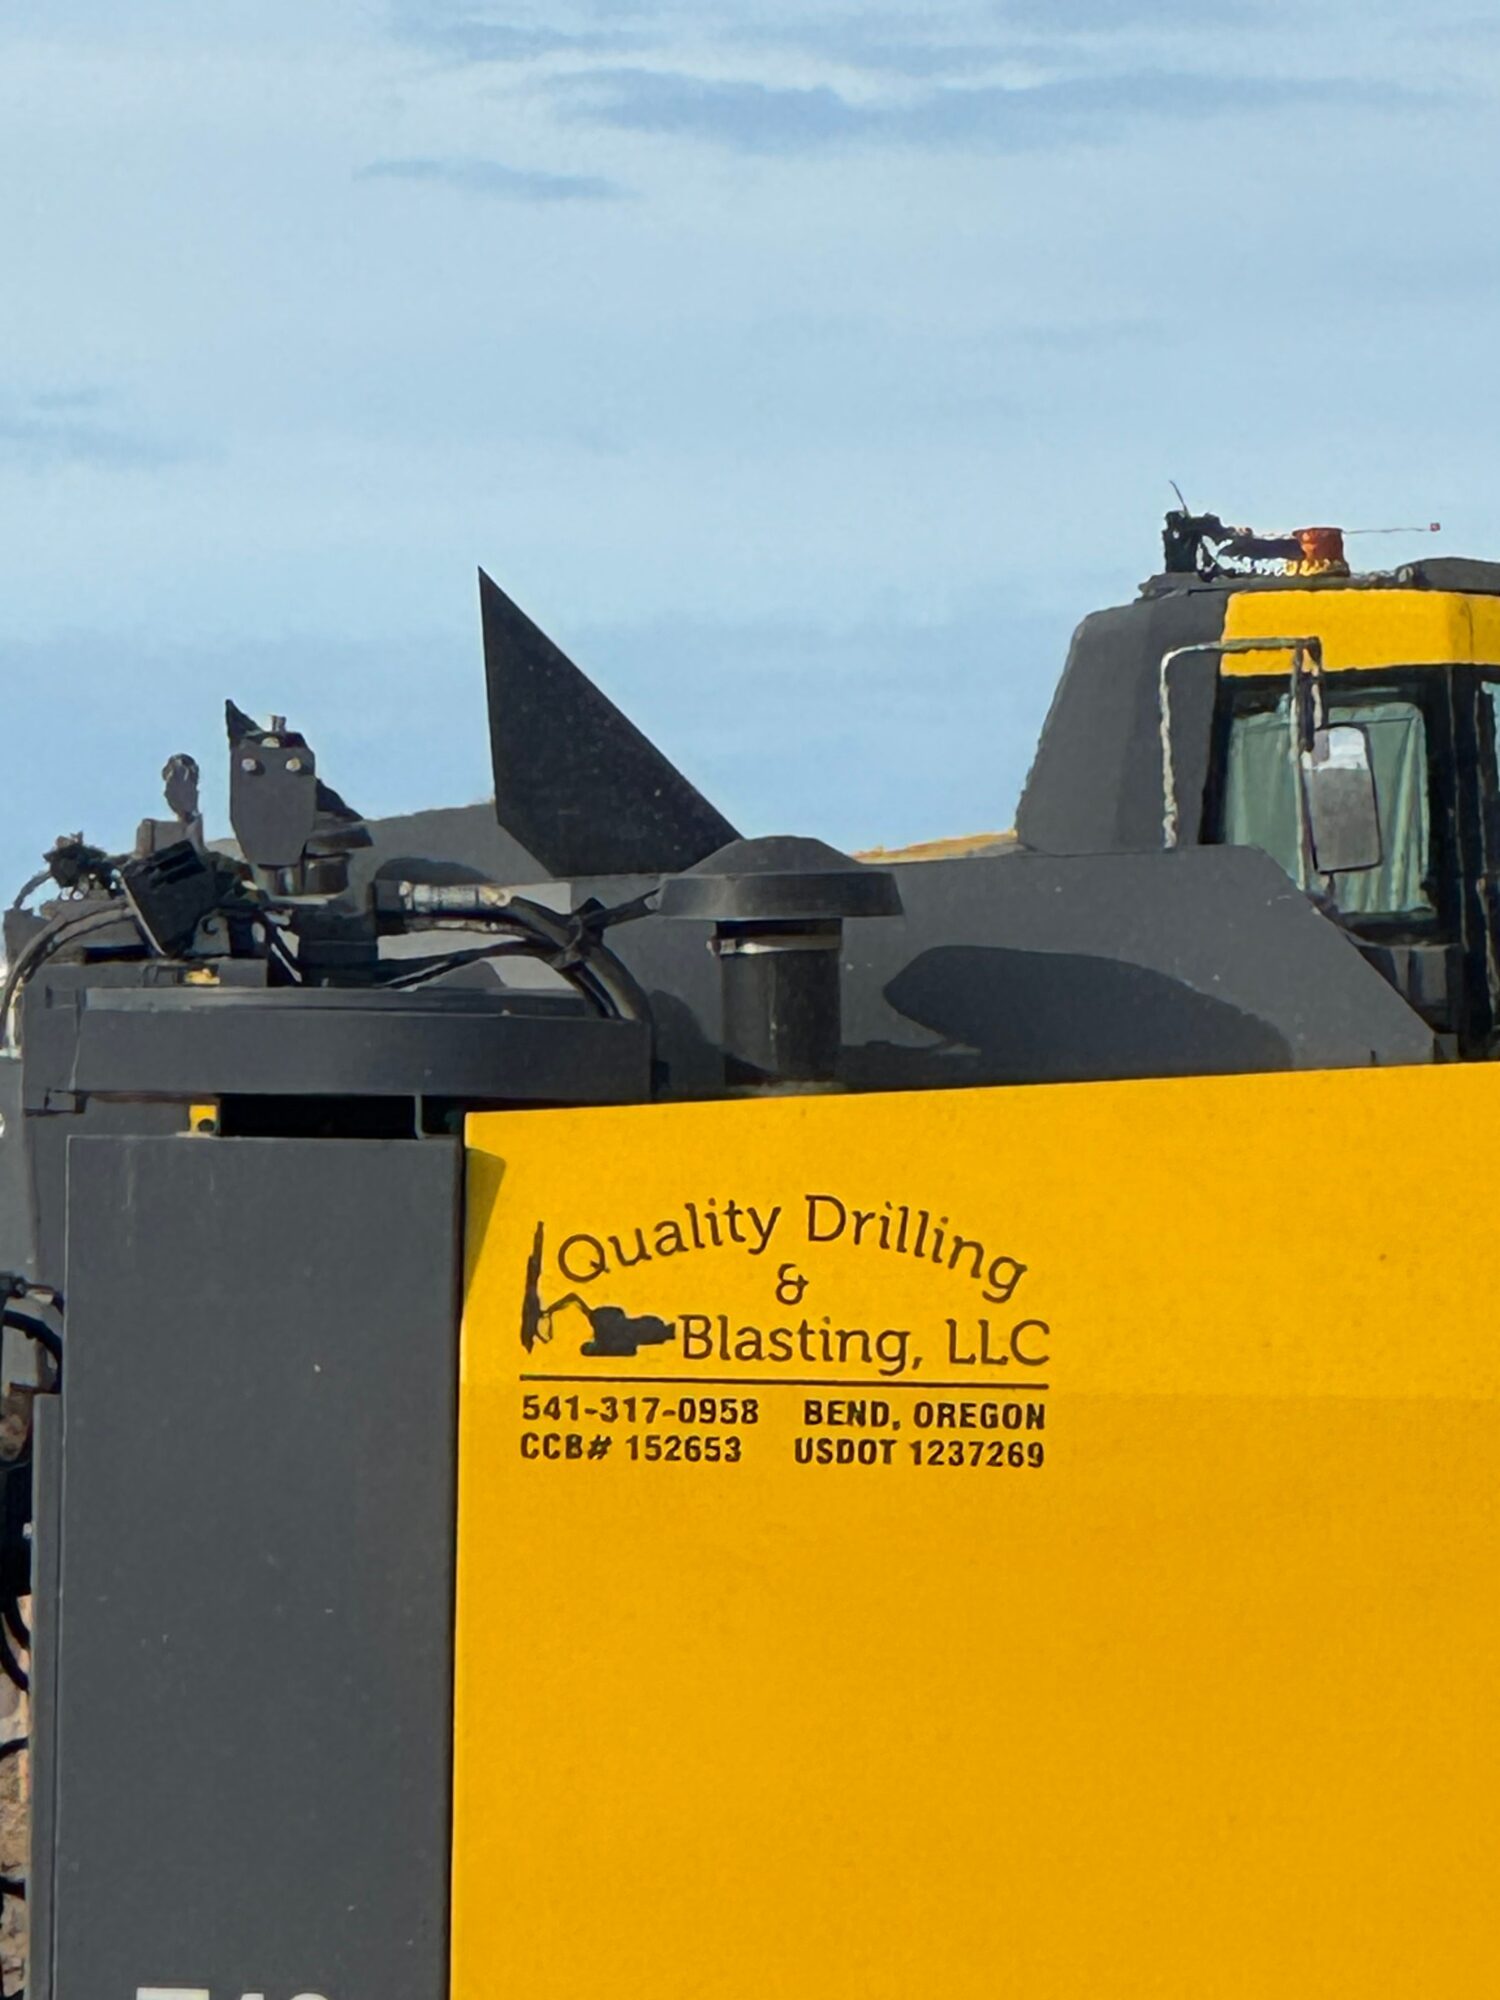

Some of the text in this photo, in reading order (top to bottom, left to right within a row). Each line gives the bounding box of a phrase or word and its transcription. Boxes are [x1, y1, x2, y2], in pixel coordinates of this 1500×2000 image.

[557, 1194, 1028, 1303] Quality Drilling
[775, 1263, 809, 1306] &
[678, 1314, 1050, 1376] Blasting, LLC
[522, 1394, 759, 1425] 541-317-0958
[804, 1399, 1045, 1431] BEND, OREGON
[520, 1431, 742, 1463] CCB# 152653
[794, 1437, 1045, 1469] USDOT 1237269
